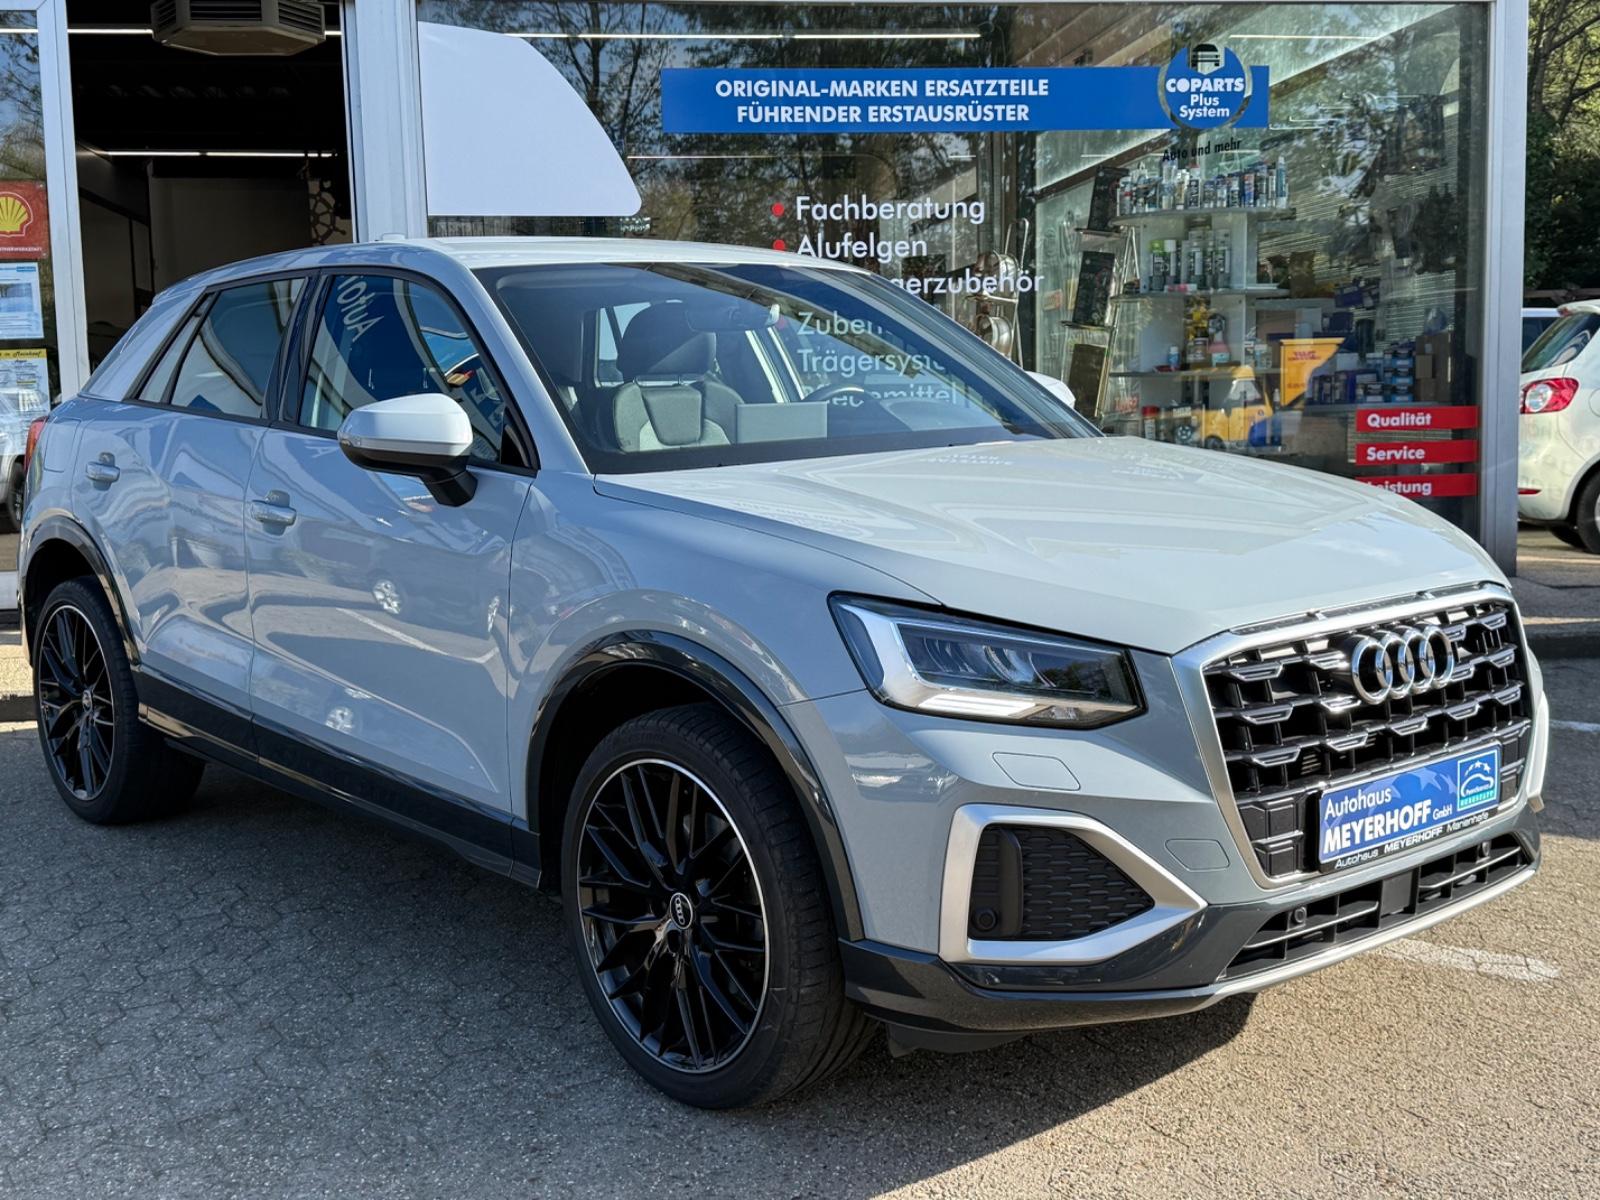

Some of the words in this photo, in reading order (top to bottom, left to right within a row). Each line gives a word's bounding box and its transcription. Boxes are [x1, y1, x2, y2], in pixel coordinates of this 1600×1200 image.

[715, 79, 918, 98] ORIGINAL-MARKEN
[925, 78, 1049, 97] ERSATZTEILE
[1165, 77, 1245, 93] COPARTS
[1190, 93, 1220, 106] Plus
[736, 101, 862, 123] FÜHRENDER
[868, 100, 1030, 122] ERSTAUSRÜSTER
[1179, 105, 1230, 121] System
[1163, 147, 1188, 162] Auto
[1191, 140, 1211, 156] und
[1214, 137, 1242, 153] mehr
[796, 193, 986, 224] Fachberatung
[797, 232, 928, 264] Alufelgen
[1366, 412, 1432, 428] Qualität
[1366, 445, 1426, 461] Service
[1324, 787, 1393, 820] Autohaus
[1323, 798, 1432, 855] MEYERHOFF
[1432, 803, 1453, 821] GmbH
[1335, 848, 1379, 869] Autohaus
[1384, 825, 1443, 854] MEYERHOFF
